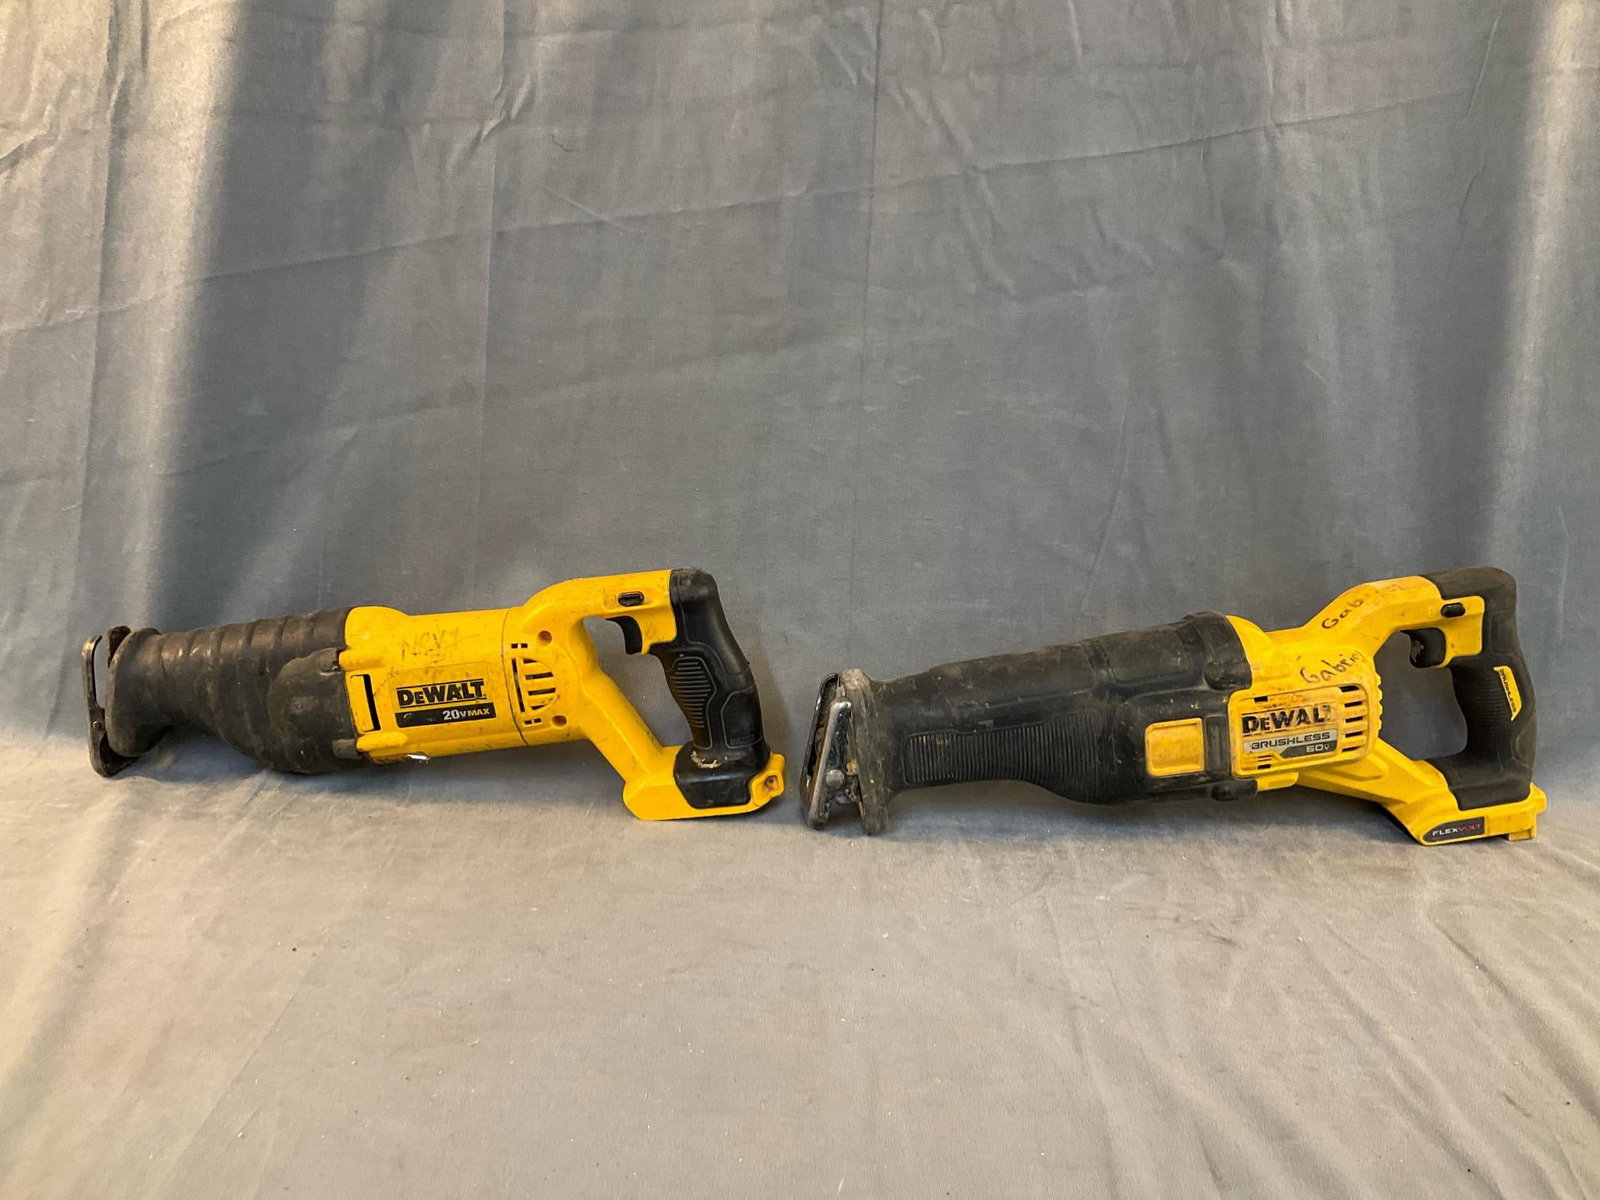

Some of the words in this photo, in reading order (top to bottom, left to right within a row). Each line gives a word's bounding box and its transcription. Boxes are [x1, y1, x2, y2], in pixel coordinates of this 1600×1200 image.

[1321, 598, 1364, 630] Gab
[1251, 732, 1330, 750] BRUSHLESS
[1432, 823, 1482, 837] FLEXVOLT
